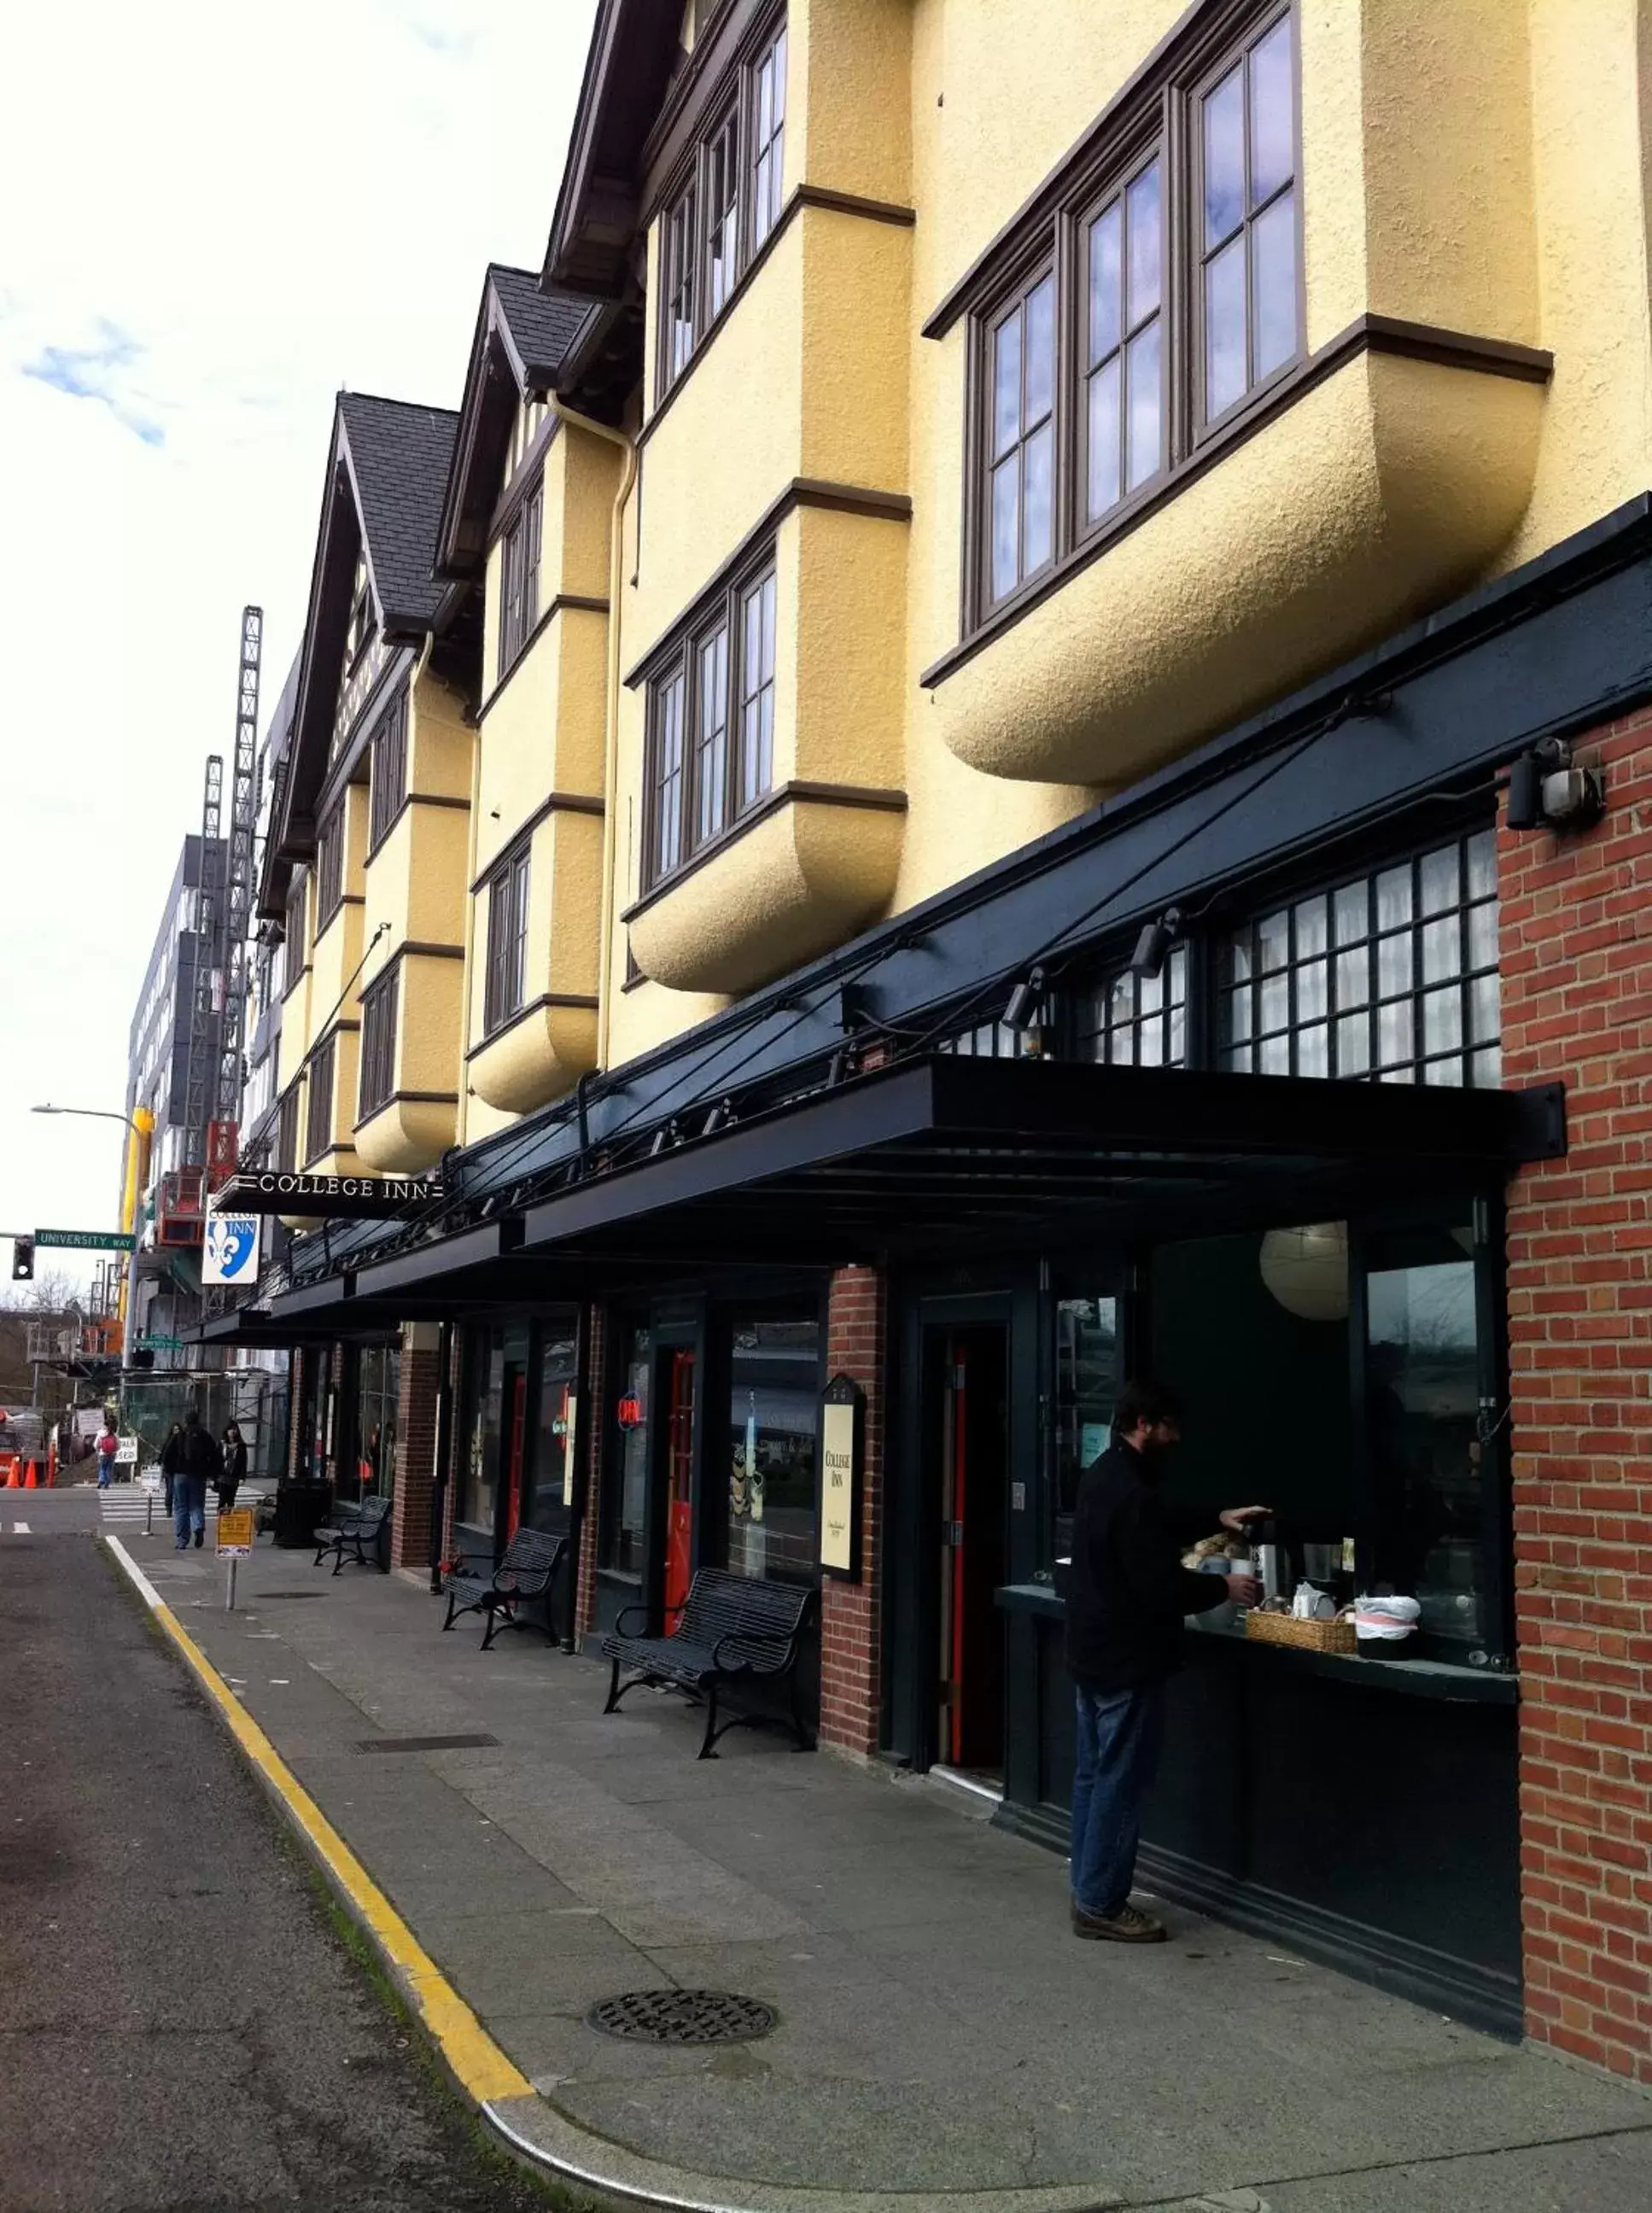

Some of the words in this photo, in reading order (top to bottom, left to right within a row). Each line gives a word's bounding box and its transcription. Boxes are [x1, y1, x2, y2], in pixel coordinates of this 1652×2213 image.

[260, 1174, 373, 1195] COLLEGE
[382, 1181, 429, 1200] INN
[229, 1222, 255, 1235] INN
[40, 1232, 107, 1246] UNIVERSITY
[113, 1239, 131, 1247] WAY
[826, 1451, 850, 1469] COLLEGE
[832, 1470, 844, 1487] INN
